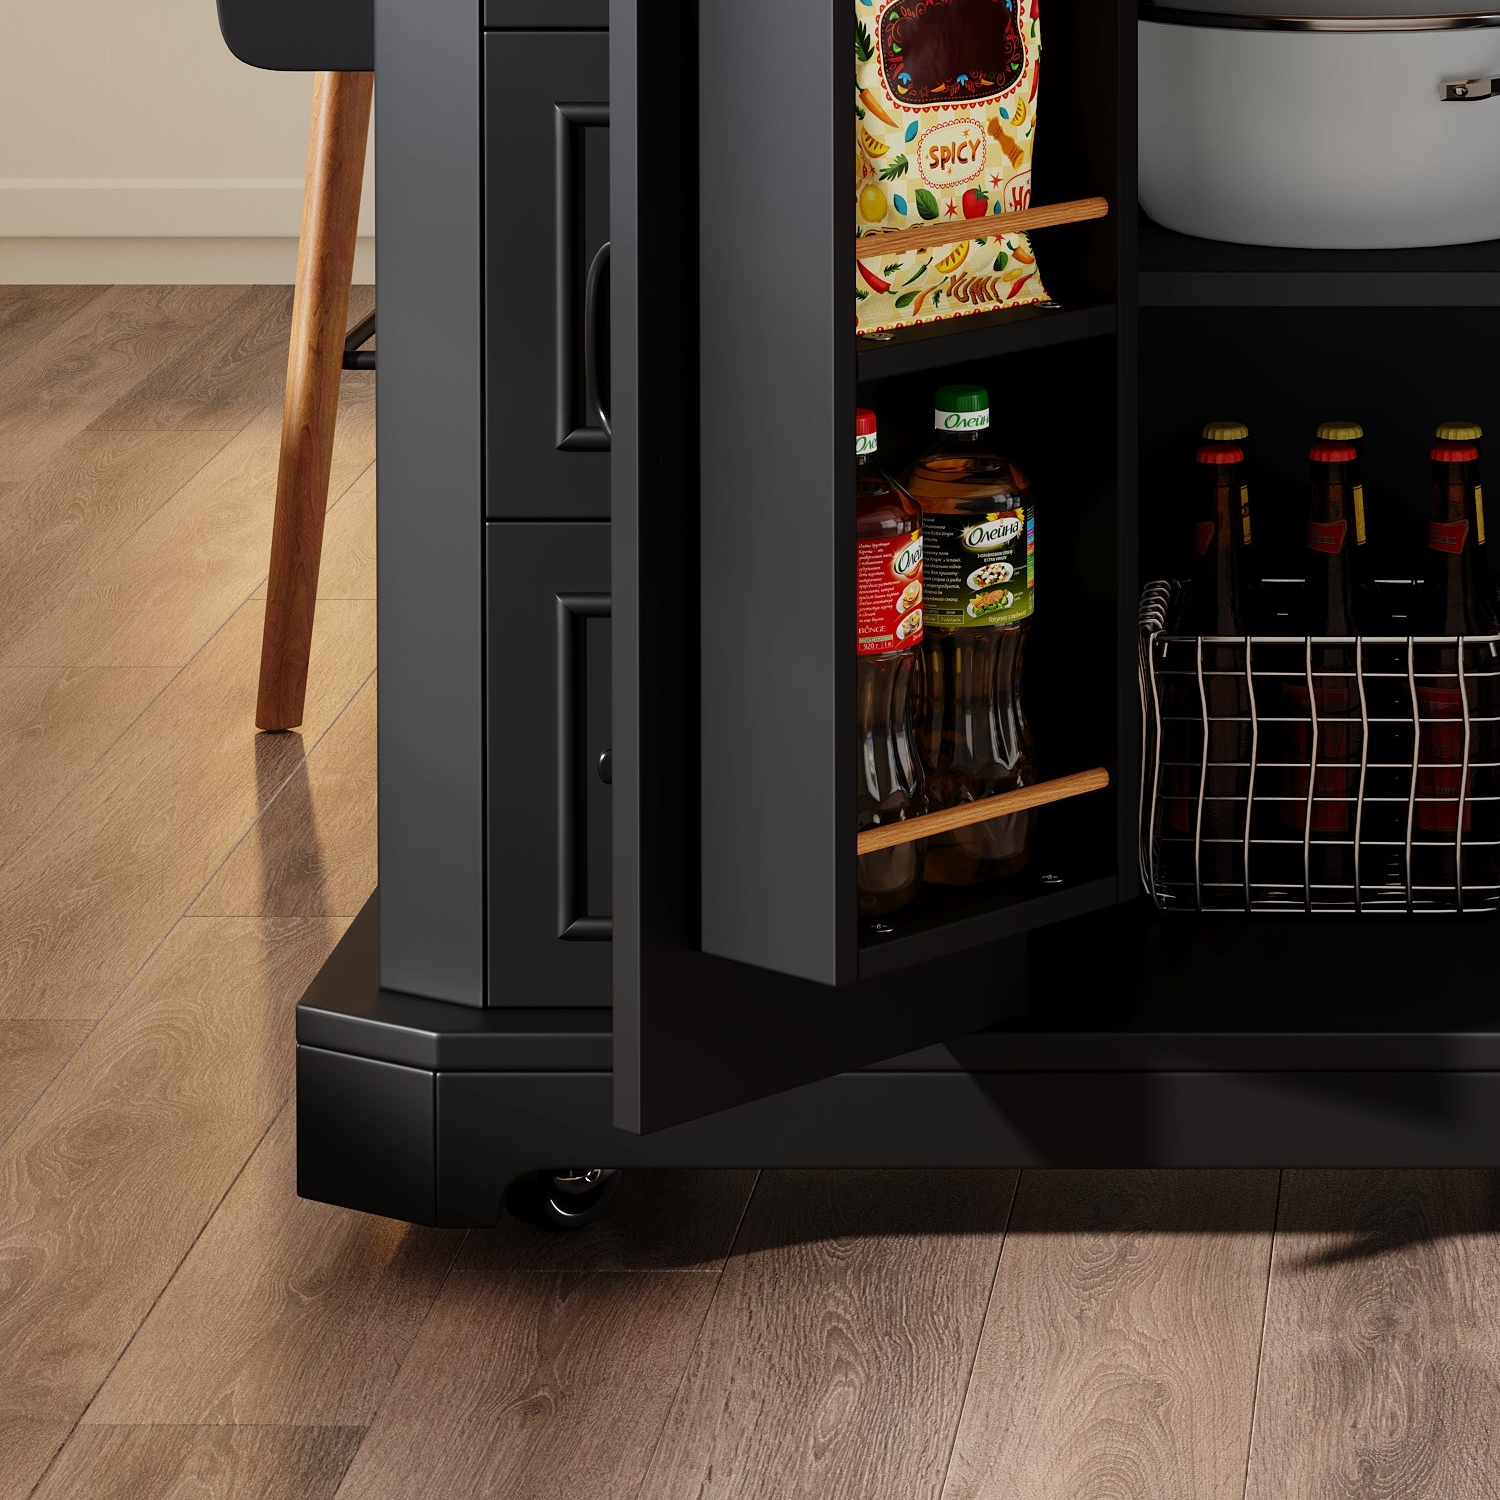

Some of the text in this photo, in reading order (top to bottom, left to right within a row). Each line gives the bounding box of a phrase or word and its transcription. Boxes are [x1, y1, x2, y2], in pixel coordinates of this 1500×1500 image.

[928, 138, 981, 171] SPICY
[946, 271, 1004, 305] YUM!
[968, 521, 1019, 546] Олейна
